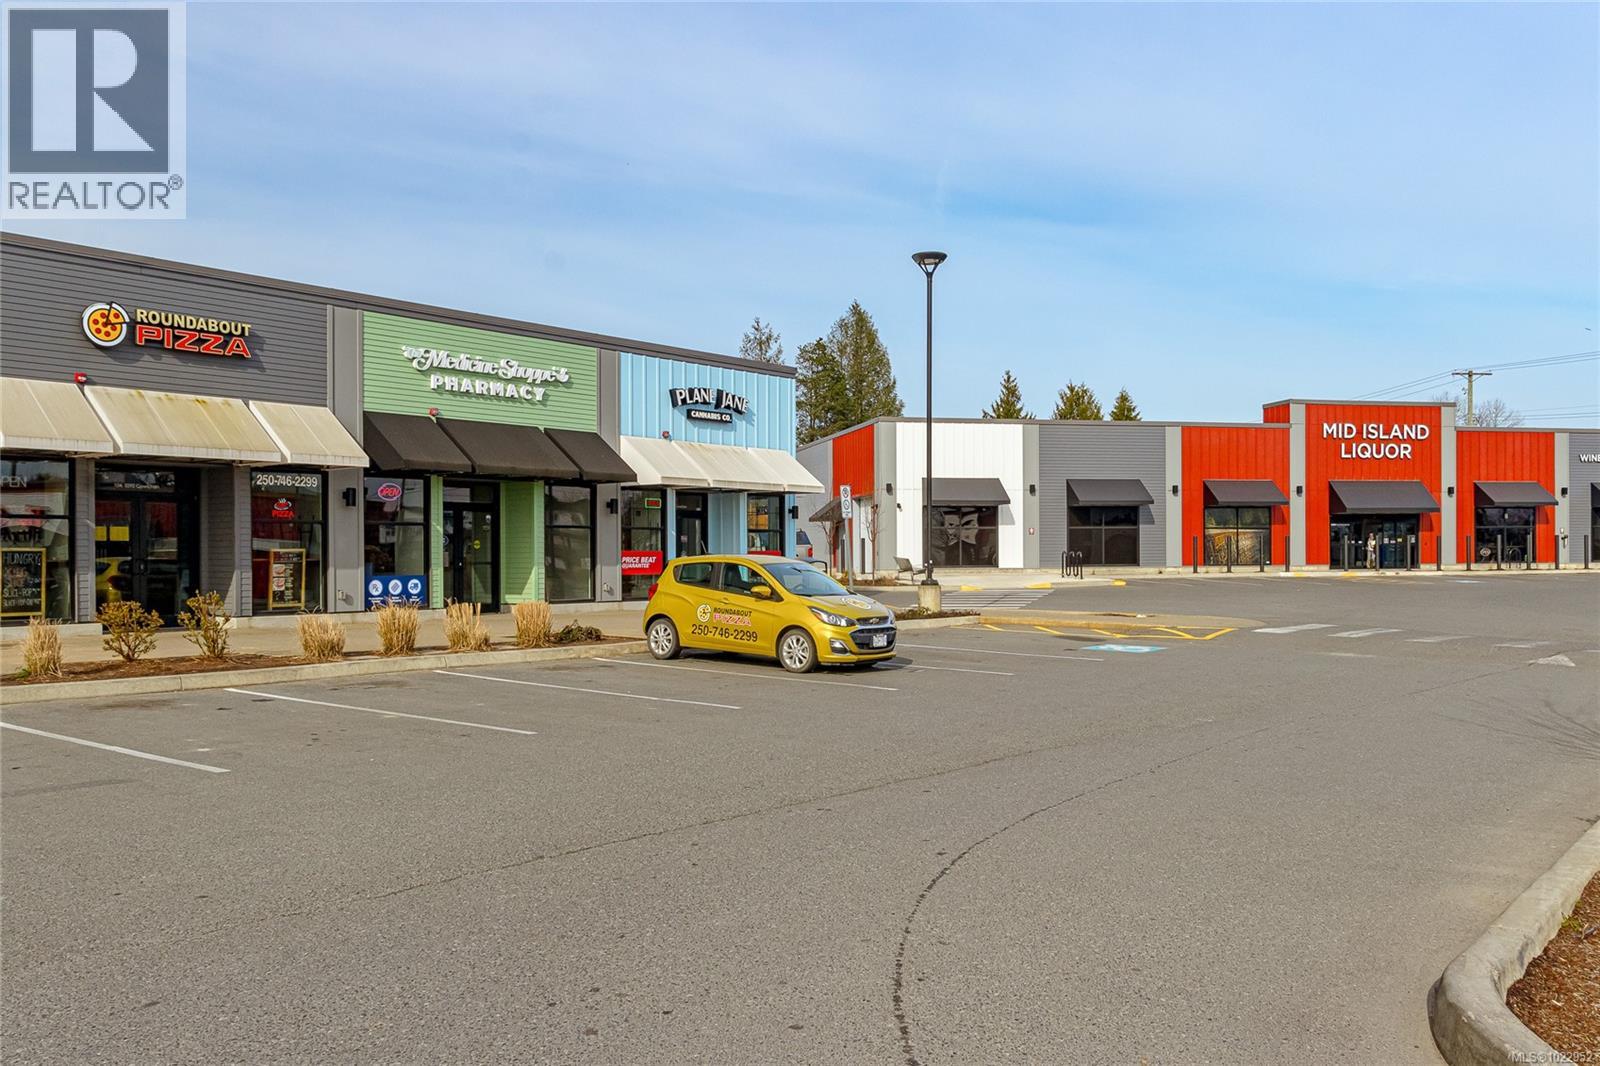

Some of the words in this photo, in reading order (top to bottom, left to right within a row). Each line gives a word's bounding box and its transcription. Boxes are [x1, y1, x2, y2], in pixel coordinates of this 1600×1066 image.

[135, 308, 252, 337] ROUNDABOUT
[135, 324, 252, 358] PIZZA
[412, 348, 499, 375] Medicine
[498, 358, 556, 384] Shoppe
[430, 374, 546, 401] PHARMACY
[674, 387, 717, 406] PLANE
[720, 390, 750, 413] JANE
[690, 410, 721, 420] CANNABIS
[1323, 422, 1357, 439] MID
[1362, 423, 1430, 440] ISLAND
[1340, 442, 1412, 460] LIQUOR
[256, 474, 318, 488] 250-746-2299
[271, 509, 295, 518] PIZZA
[621, 556, 640, 564] PRICE
[640, 556, 656, 564] BEAT
[712, 612, 752, 626] PIZZA
[713, 607, 753, 617] ROUNDABOUT
[691, 623, 758, 643] 250-746-2299
